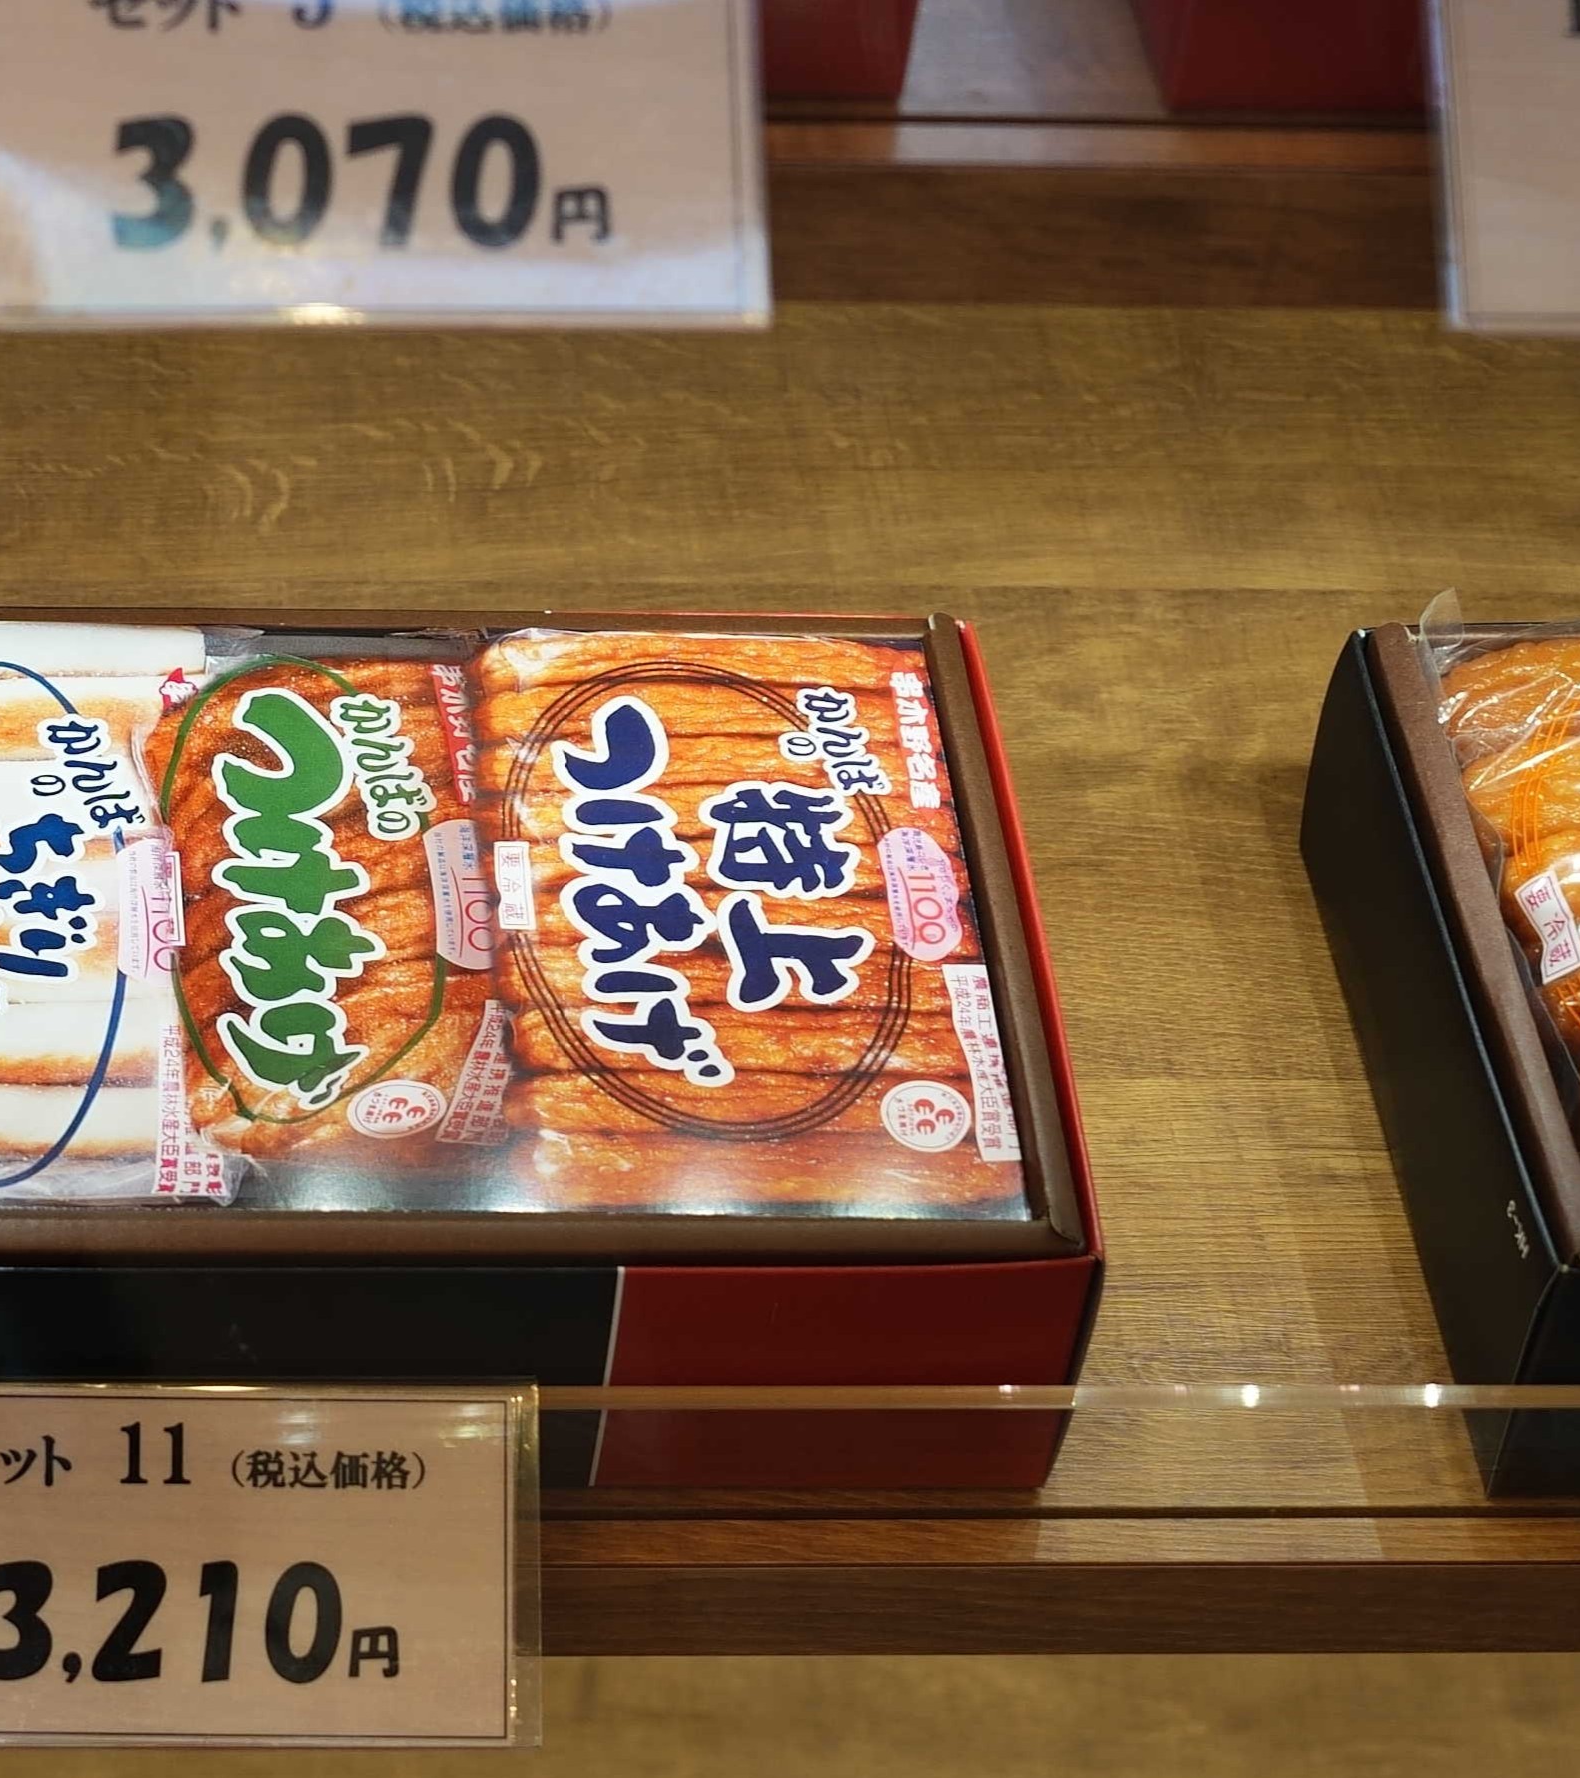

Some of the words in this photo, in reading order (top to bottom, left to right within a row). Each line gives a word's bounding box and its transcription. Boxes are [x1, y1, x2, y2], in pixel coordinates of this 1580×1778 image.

[29, 718, 146, 828] かんばの
[339, 697, 431, 838] かんばの
[785, 688, 887, 794] かんばの
[888, 671, 942, 814] 串木野名産
[219, 692, 381, 1104] つけあげ
[561, 701, 726, 1082] つけあげ
[708, 787, 864, 1005] 特上
[904, 872, 948, 946] 1100
[119, 1421, 192, 1486] 11
[230, 1449, 428, 1491] (税込価格)
